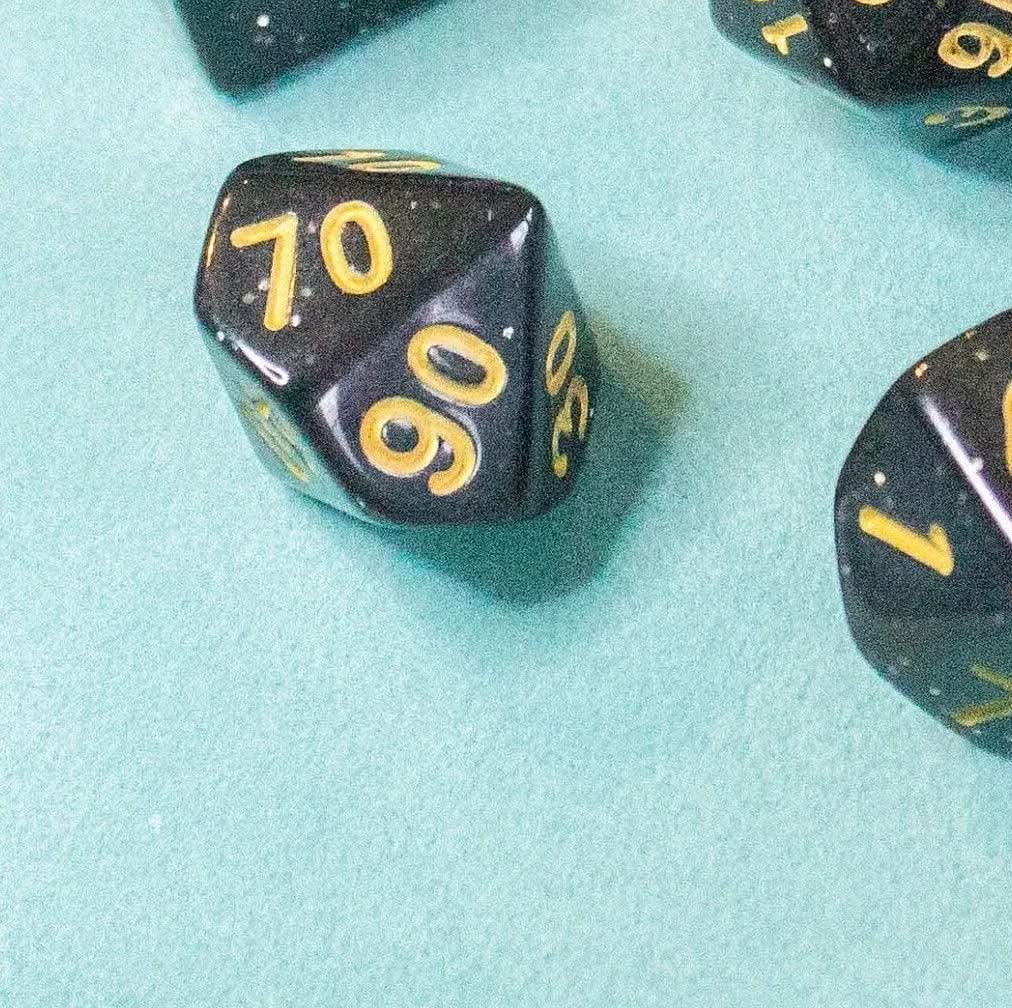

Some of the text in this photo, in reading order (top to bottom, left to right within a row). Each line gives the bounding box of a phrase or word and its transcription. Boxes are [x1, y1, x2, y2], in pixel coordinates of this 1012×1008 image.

[229, 199, 395, 333] 70
[359, 323, 509, 497] 90
[857, 506, 957, 578] 1
